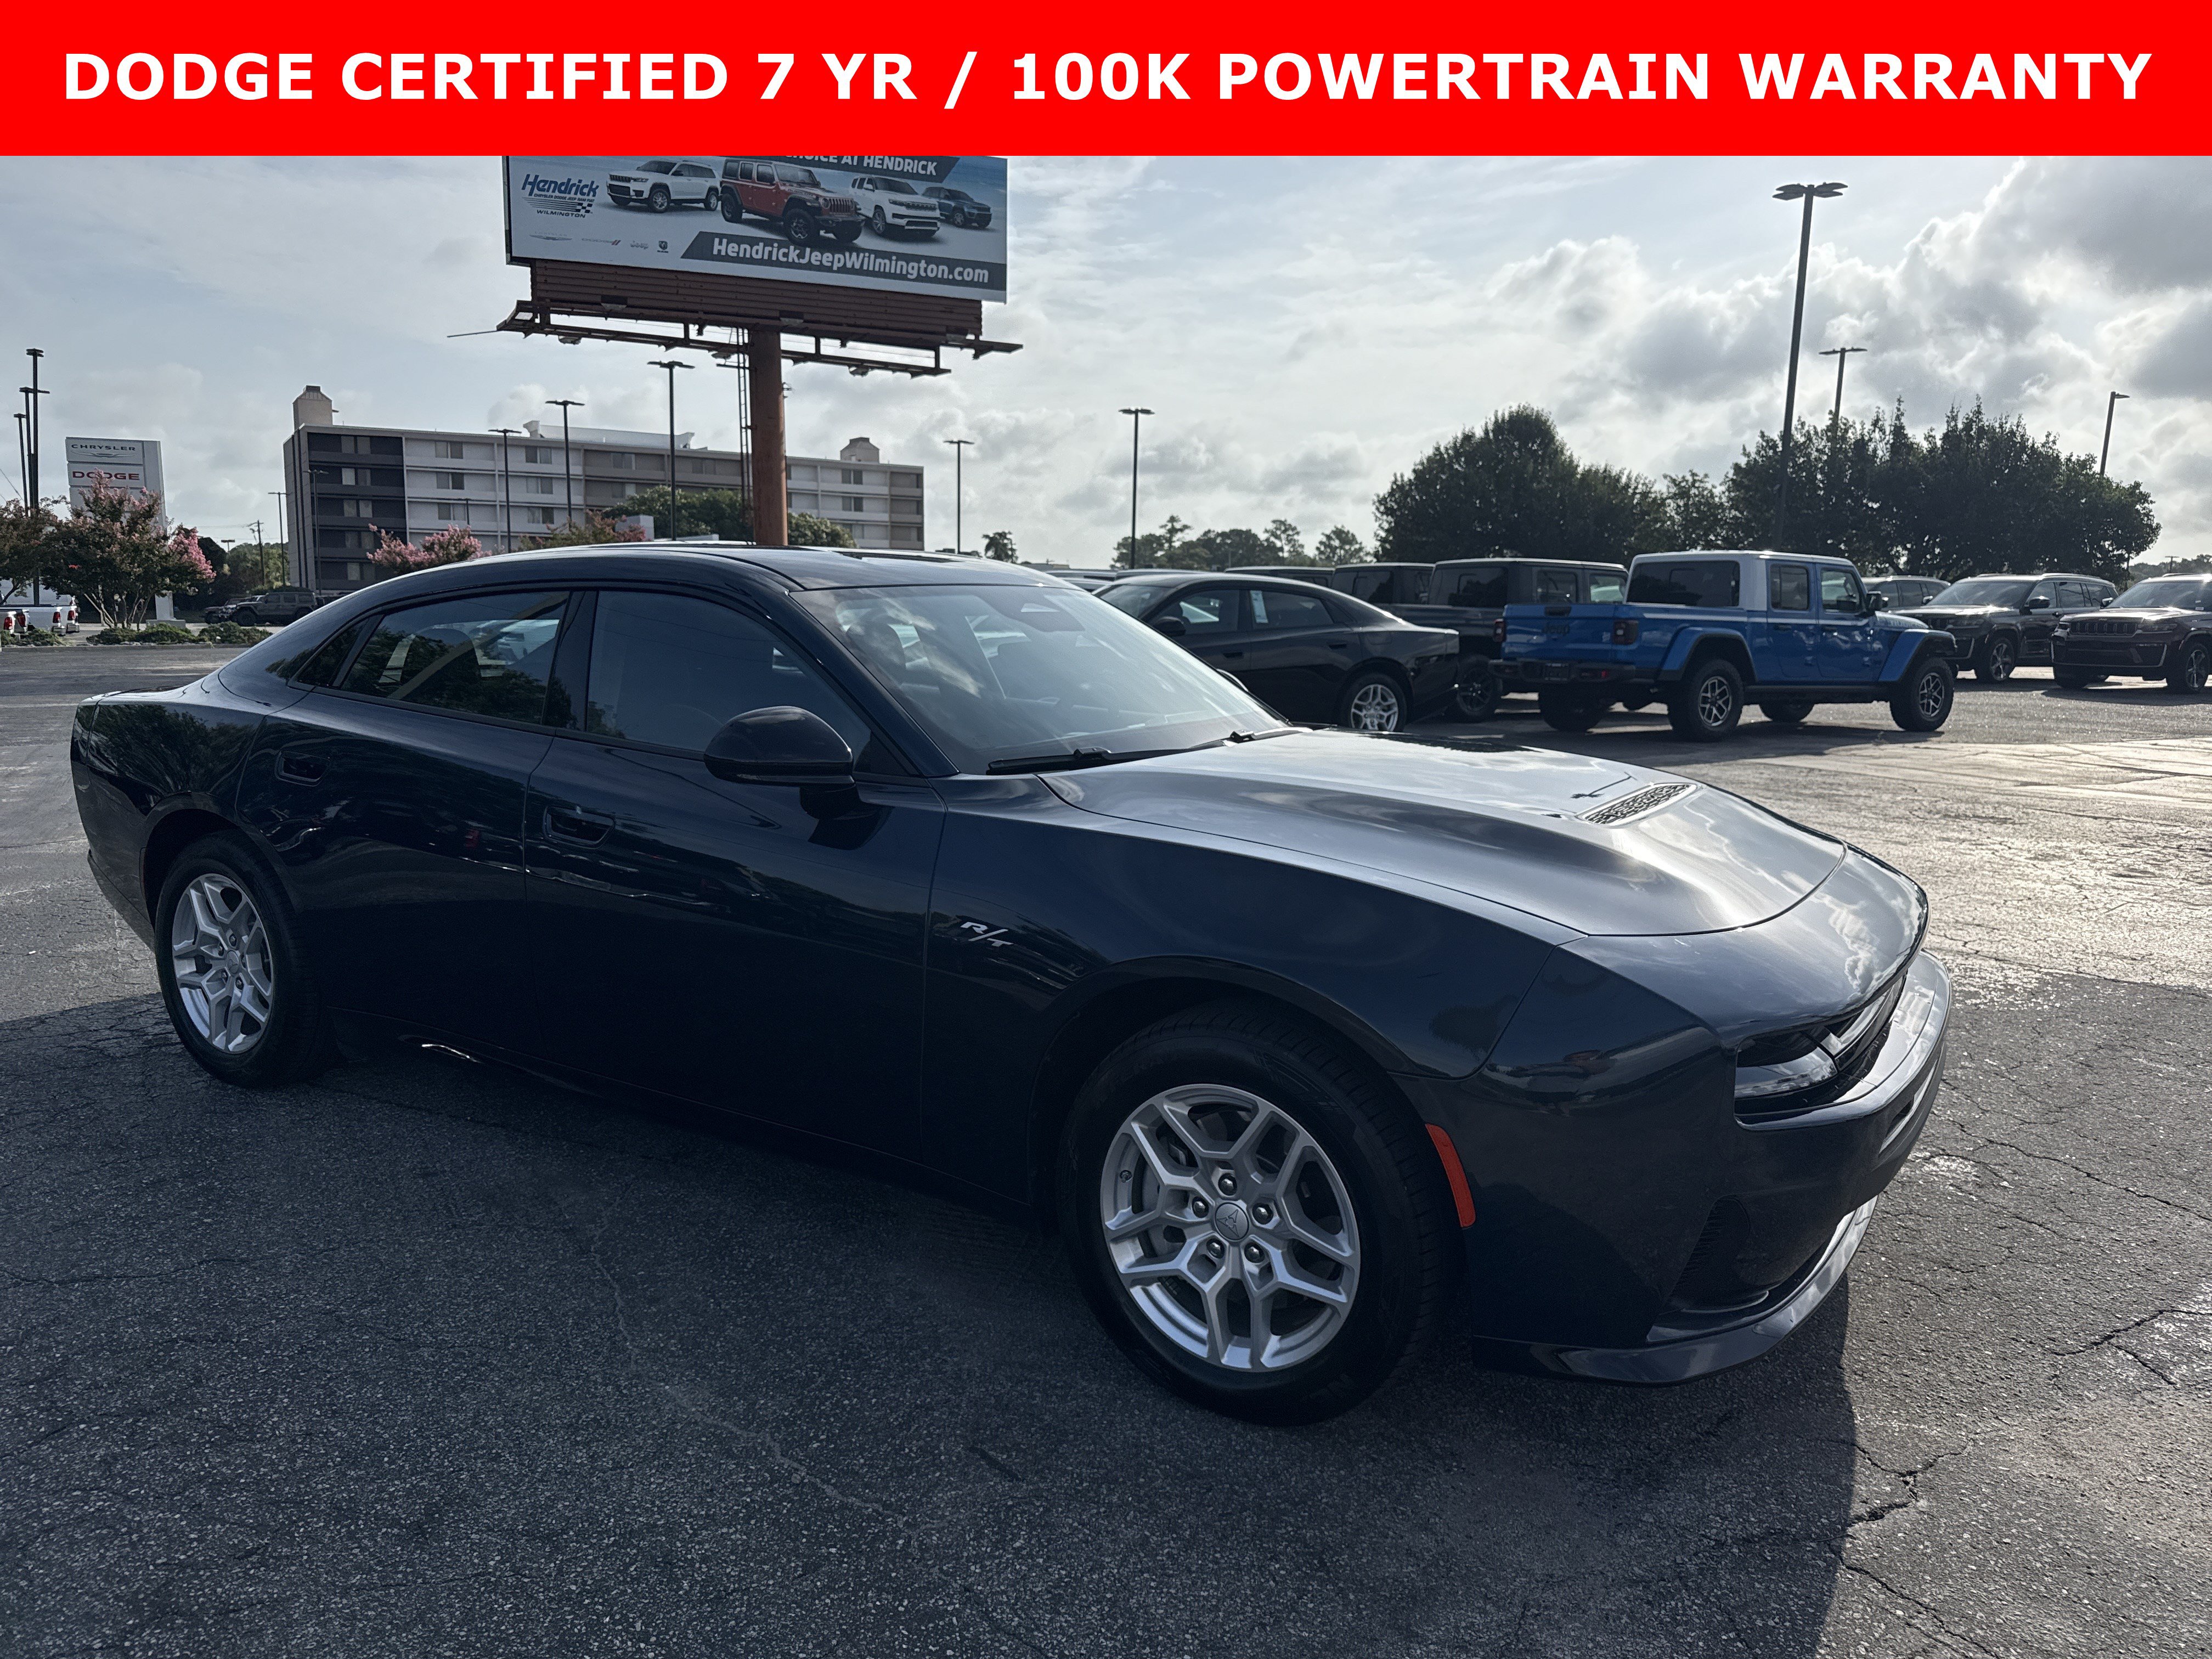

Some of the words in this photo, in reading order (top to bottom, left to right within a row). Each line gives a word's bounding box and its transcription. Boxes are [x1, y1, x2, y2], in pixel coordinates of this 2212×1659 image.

[864, 156, 938, 176] HENDRICK
[521, 174, 599, 197] Hendrick
[537, 210, 585, 218] WILMINGTON
[713, 238, 989, 283] HendrickJeepWilmington.com
[960, 922, 1014, 947] R/T
